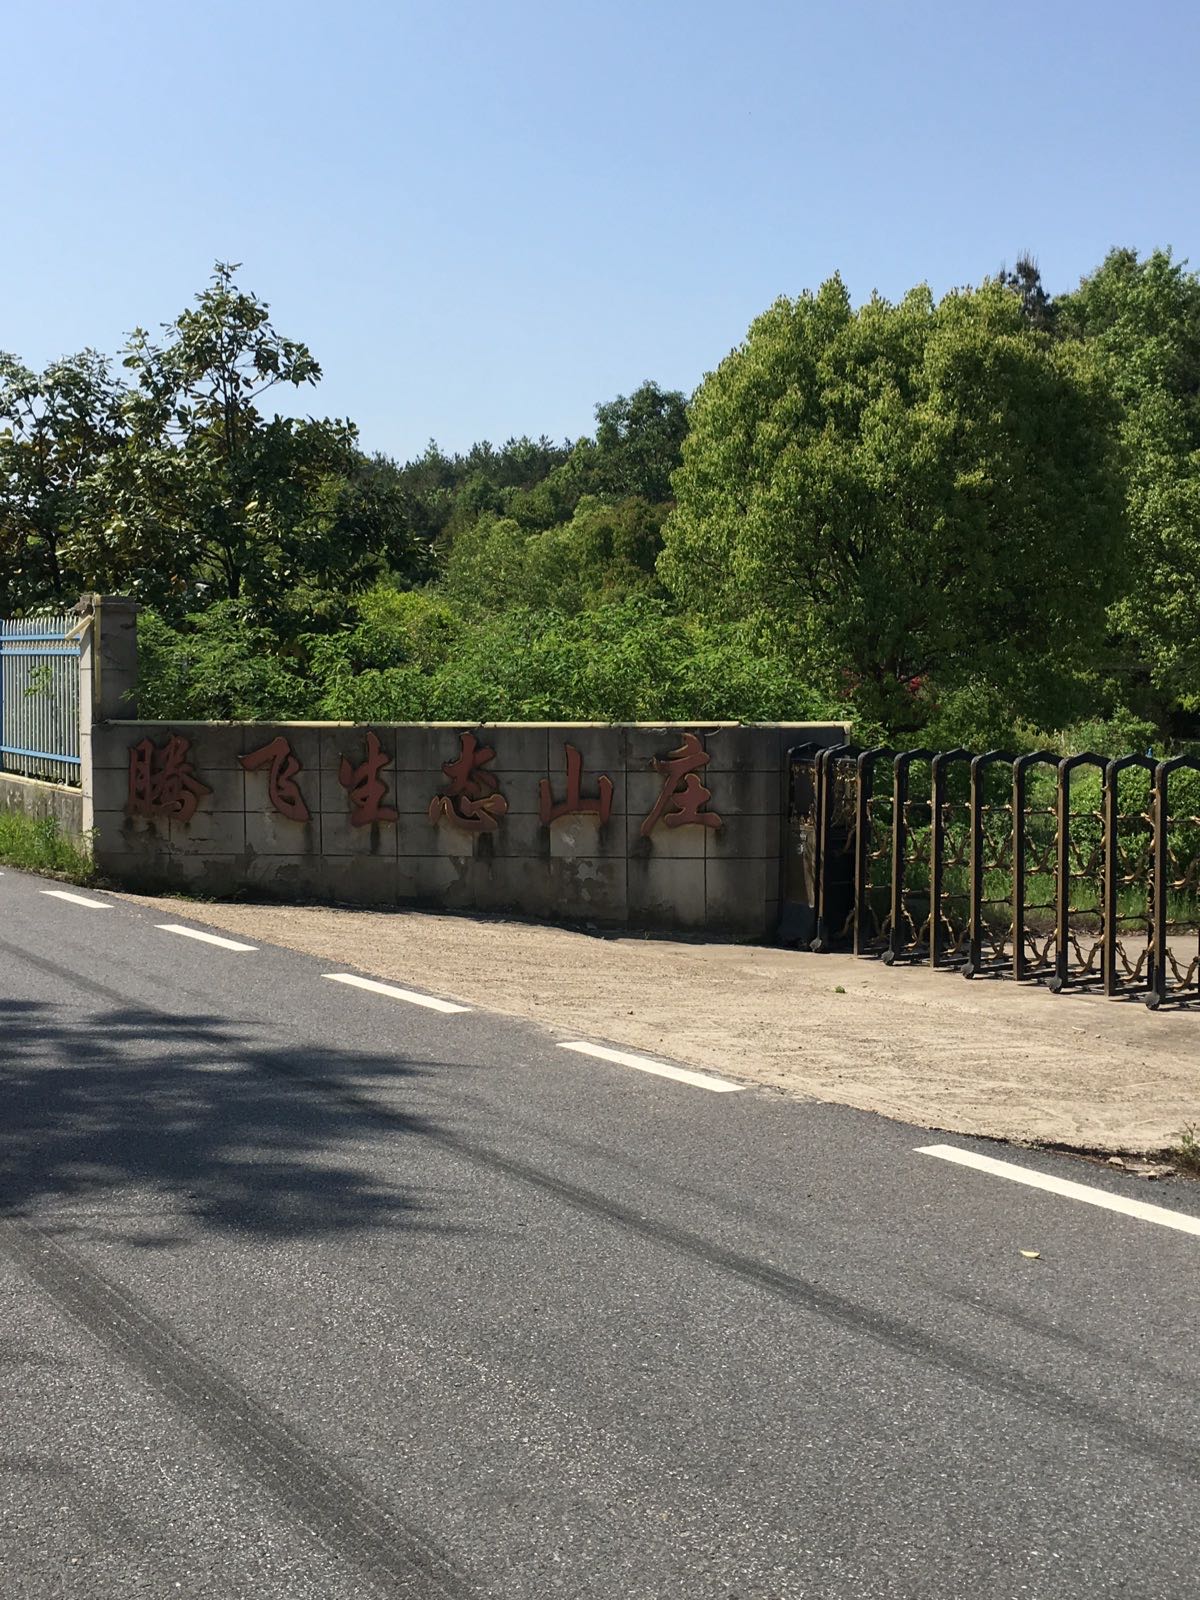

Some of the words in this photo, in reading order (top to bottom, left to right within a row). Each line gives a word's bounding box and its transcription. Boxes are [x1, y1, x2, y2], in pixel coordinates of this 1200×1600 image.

[128, 731, 722, 835] 腾飞生态山庄
